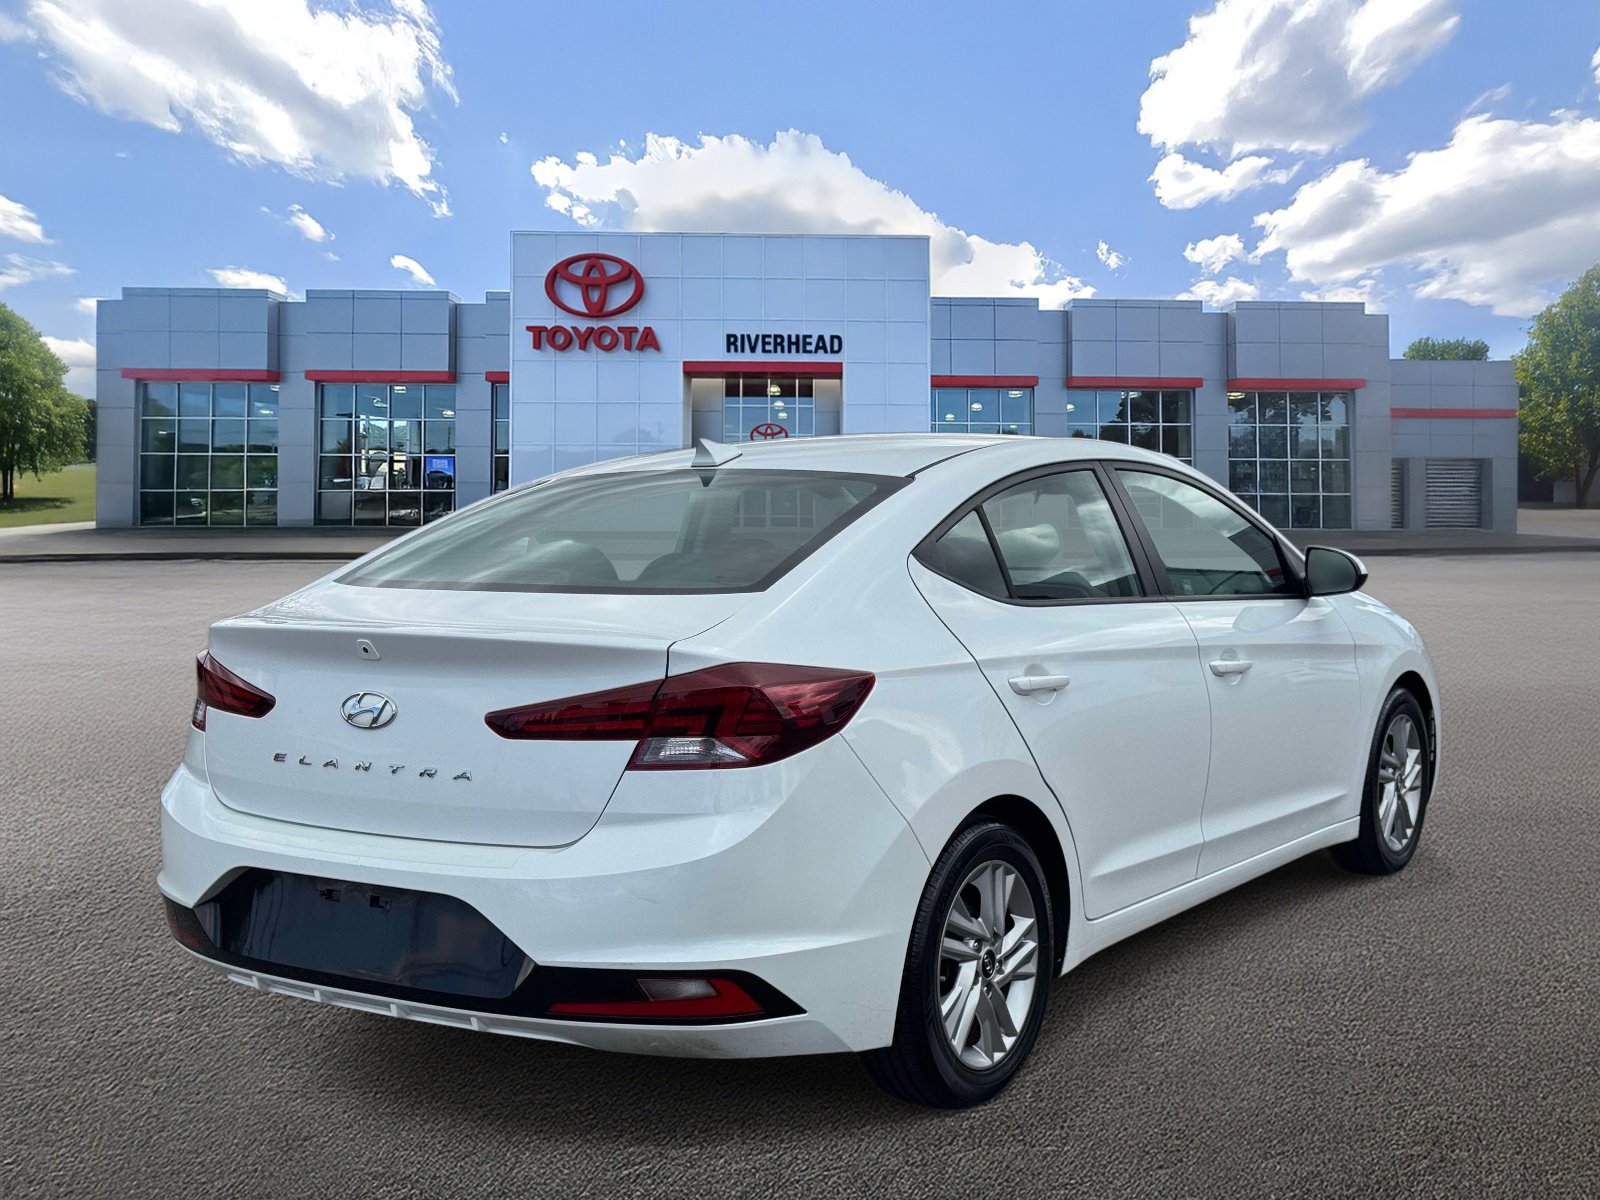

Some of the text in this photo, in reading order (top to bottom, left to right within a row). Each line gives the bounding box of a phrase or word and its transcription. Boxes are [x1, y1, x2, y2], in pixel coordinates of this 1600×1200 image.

[526, 326, 660, 352] TOYOTA
[726, 333, 843, 354] RIVERHEAD
[273, 752, 473, 782] ELANTRA
